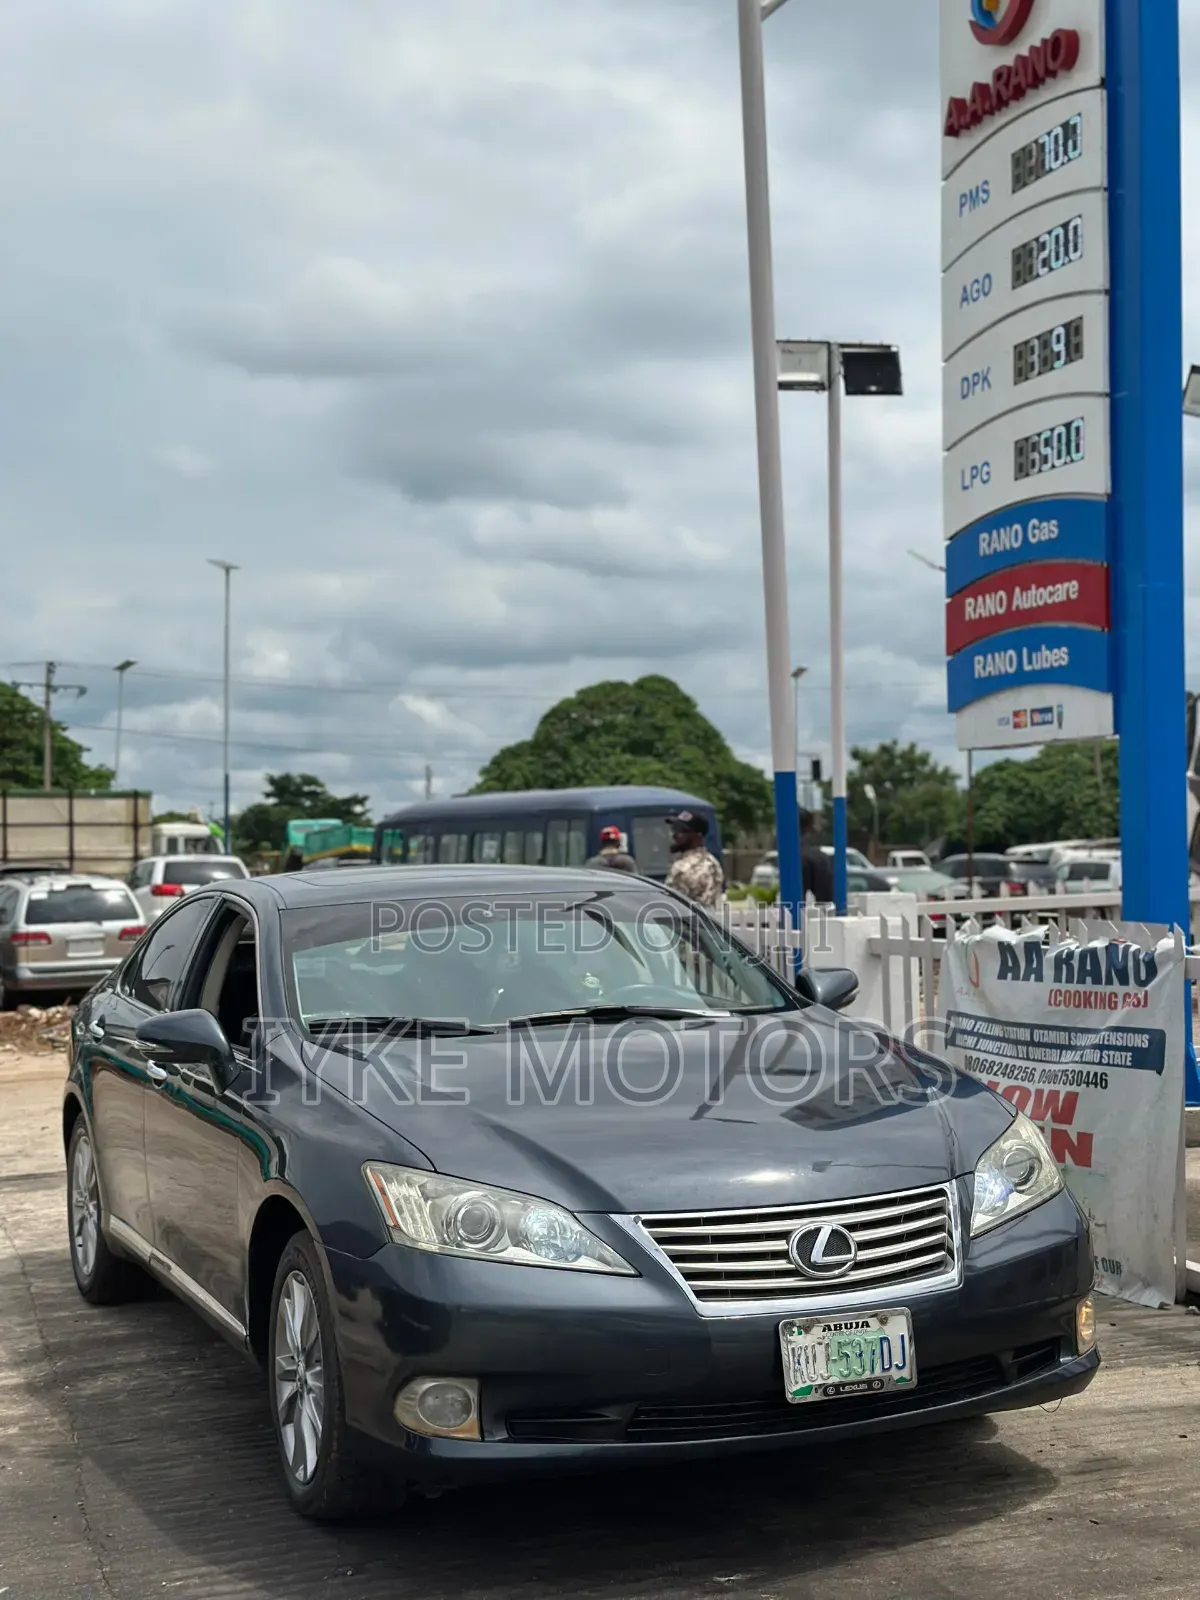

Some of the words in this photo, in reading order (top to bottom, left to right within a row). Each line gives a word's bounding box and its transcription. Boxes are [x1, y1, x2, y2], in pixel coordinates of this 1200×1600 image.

[958, 180, 990, 217] PMS
[960, 273, 992, 308] AGO
[960, 366, 991, 399] DPK
[961, 461, 991, 490] LPG
[979, 524, 1023, 556] RANO
[1027, 518, 1059, 543] Gas
[965, 591, 1007, 621] RANO
[1011, 580, 1079, 611] Autocare
[974, 650, 1017, 679] RANO
[1022, 645, 1069, 671] Lubes
[1053, 943, 1158, 988] RANO
[974, 1021, 1004, 1037] FILLING
[1033, 1029, 1068, 1045] OTAMIRI
[976, 1038, 1017, 1056] JUNCTION
[1028, 1047, 1060, 1062] OWERRI
[1102, 1050, 1132, 1066] STATE
[822, 1321, 870, 1332] ABUJA
